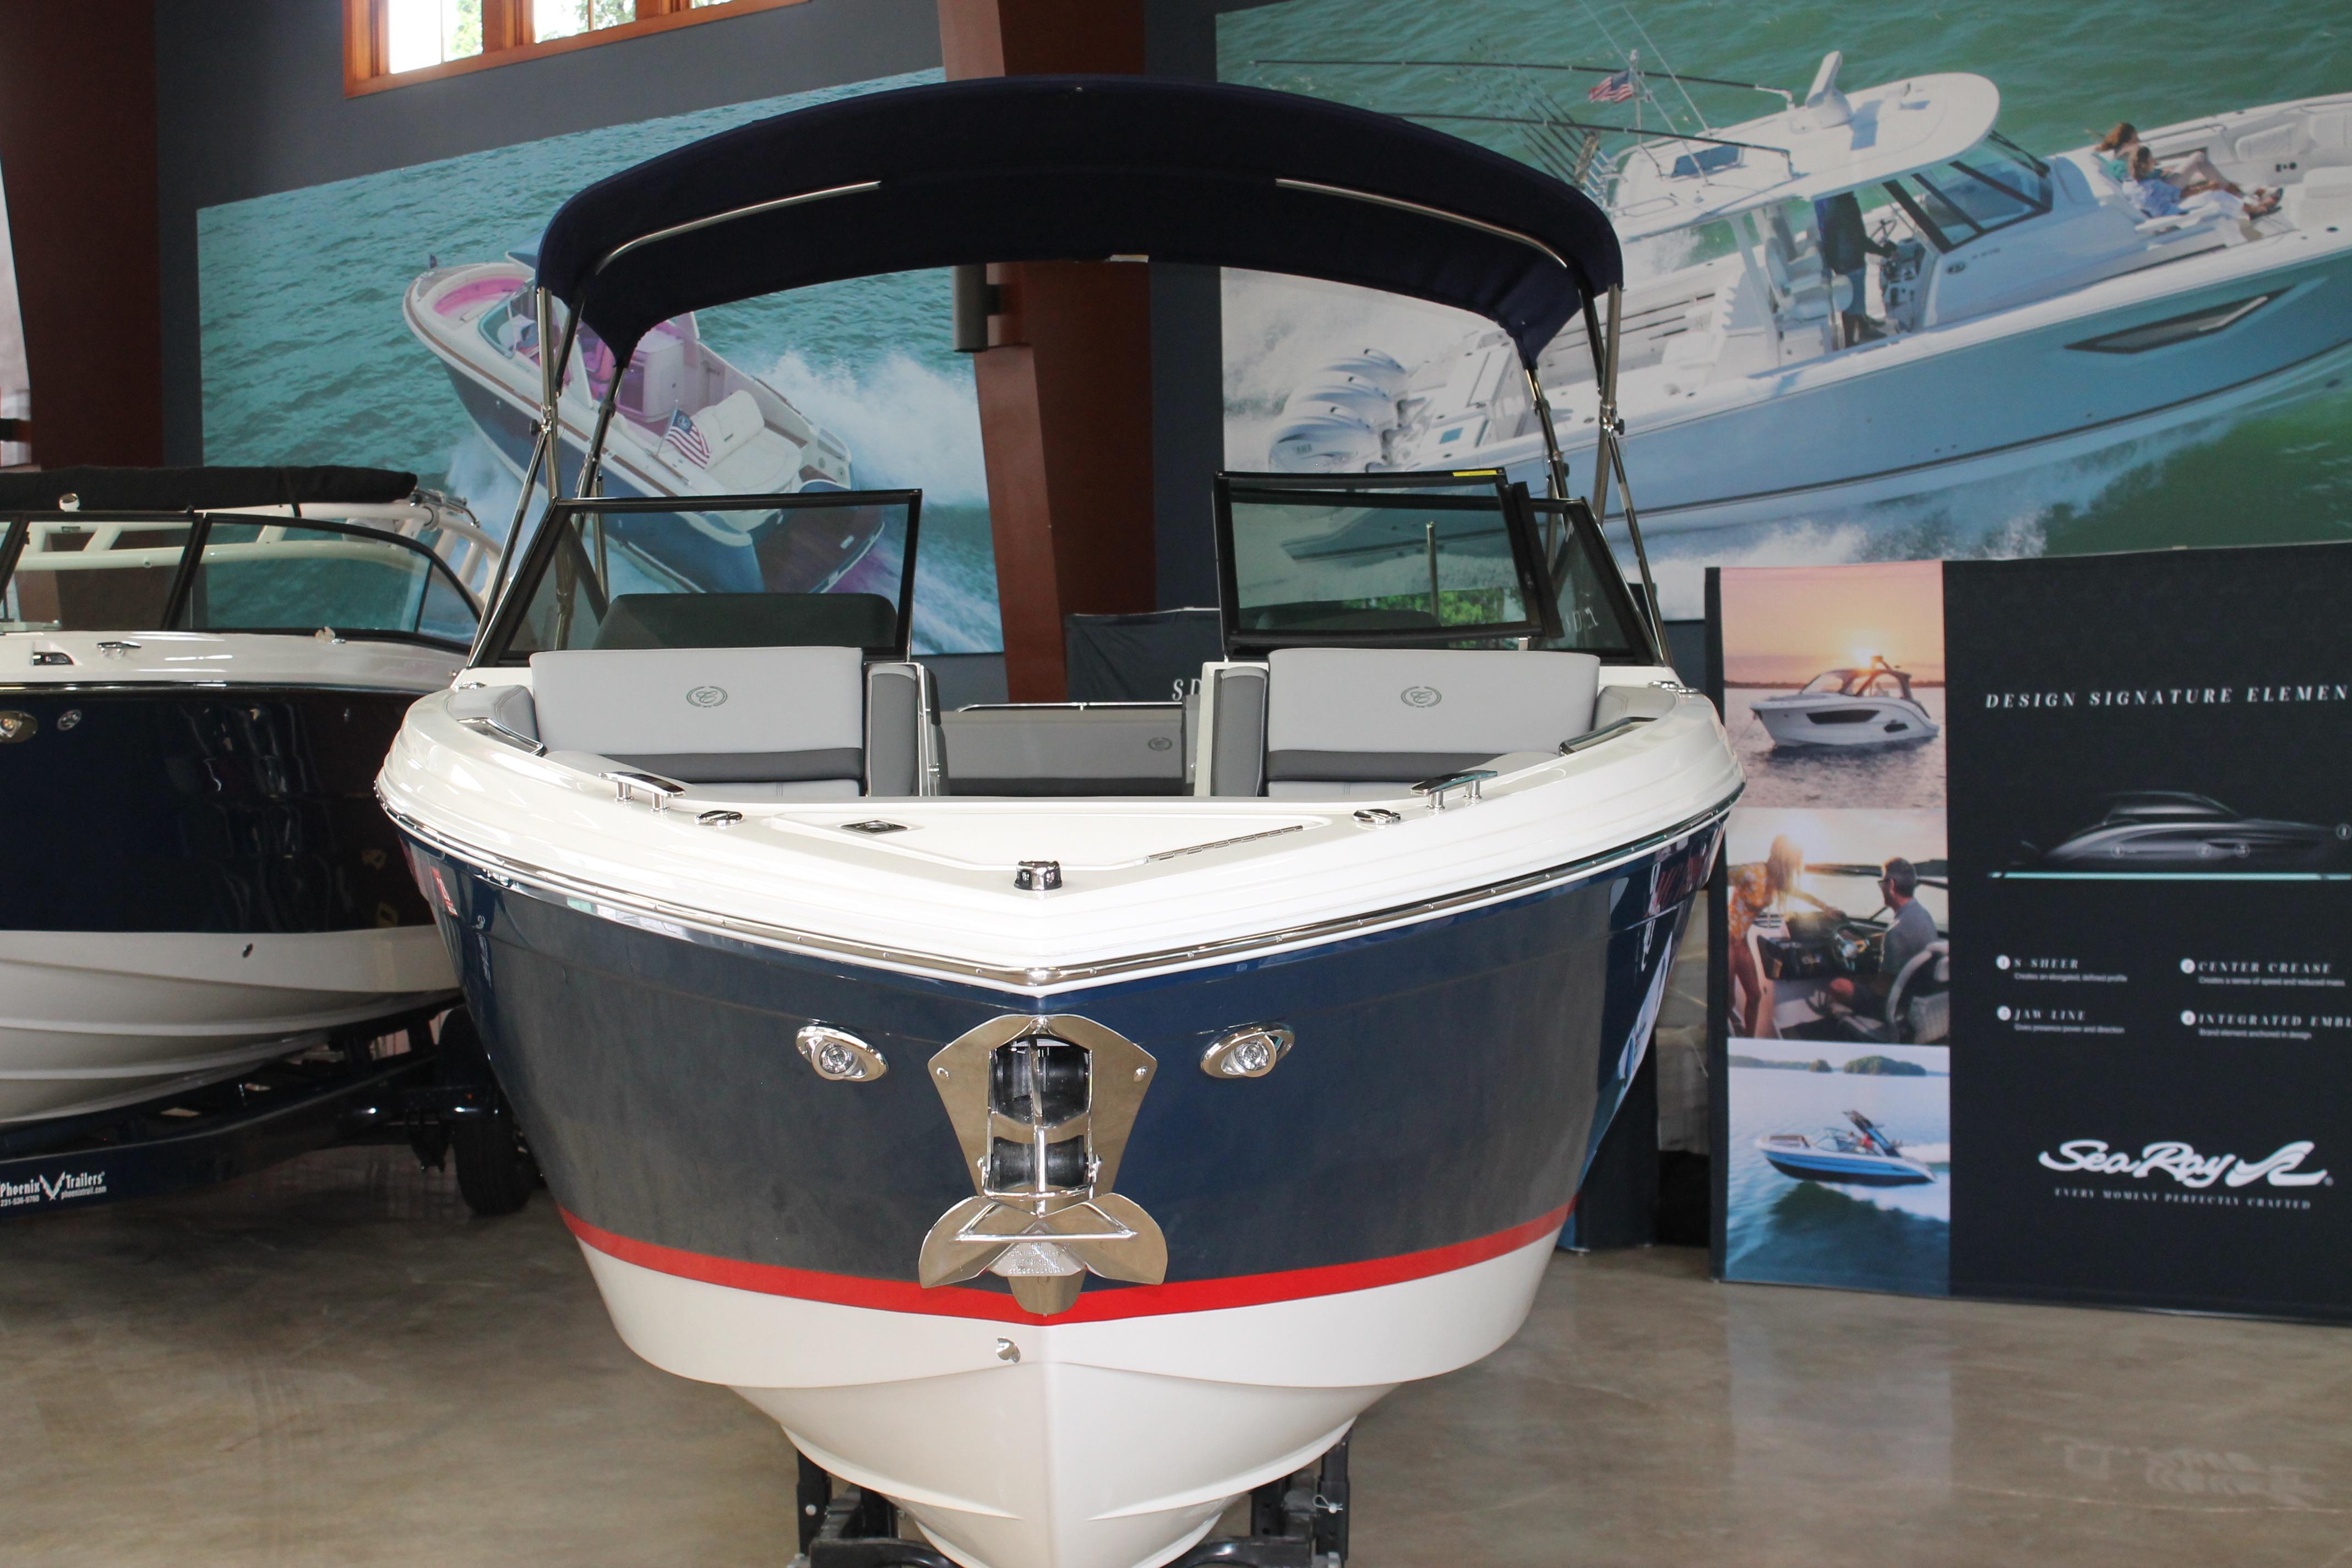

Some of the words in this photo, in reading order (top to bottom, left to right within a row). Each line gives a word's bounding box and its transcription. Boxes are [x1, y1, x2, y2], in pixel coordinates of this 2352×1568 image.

[1985, 692, 2076, 709] DESIGN
[2088, 687, 2233, 706] SIGNATURE
[2246, 684, 2348, 703] ELEMEN
[2030, 958, 2079, 970] SHEER
[2197, 961, 2260, 973] CENTER
[2267, 962, 2330, 974] CREASE
[2014, 1008, 2041, 1021] JAW
[2050, 1009, 2084, 1021] LINE
[2198, 1013, 2302, 1027] INTEGRATED
[0, 1179, 40, 1198] Phoenix
[66, 1172, 103, 1189] Trailers
